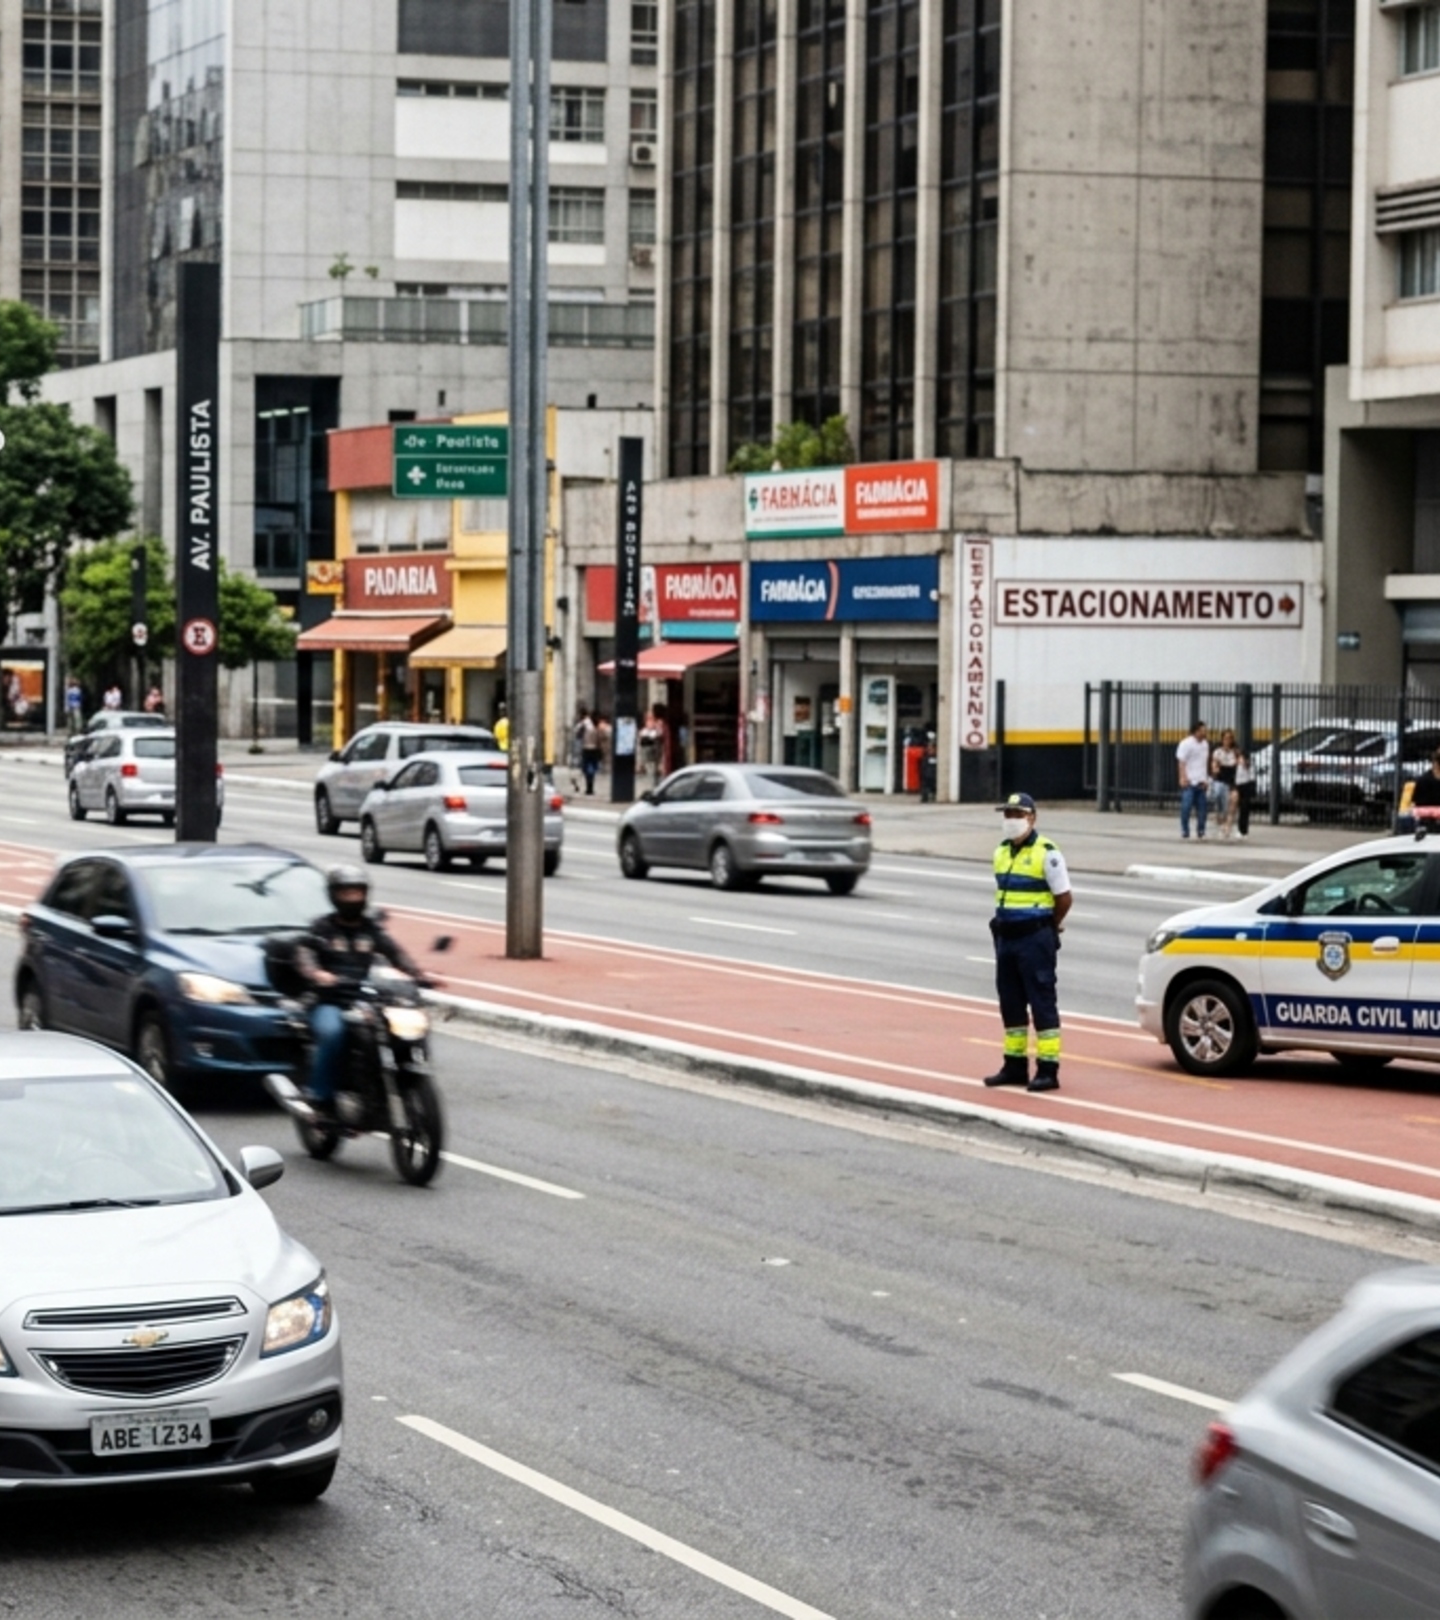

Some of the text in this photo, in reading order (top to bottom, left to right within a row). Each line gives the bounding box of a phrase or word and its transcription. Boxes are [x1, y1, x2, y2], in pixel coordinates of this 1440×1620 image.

[190, 400, 211, 570] AV. PAULISTA
[364, 565, 437, 596] PADARIA
[1003, 588, 1274, 619] ESTACIONAMENTO
[1276, 1002, 1353, 1026] GUARDA
[1356, 1006, 1407, 1028] CIVIL
[100, 1427, 142, 1451] ABE
